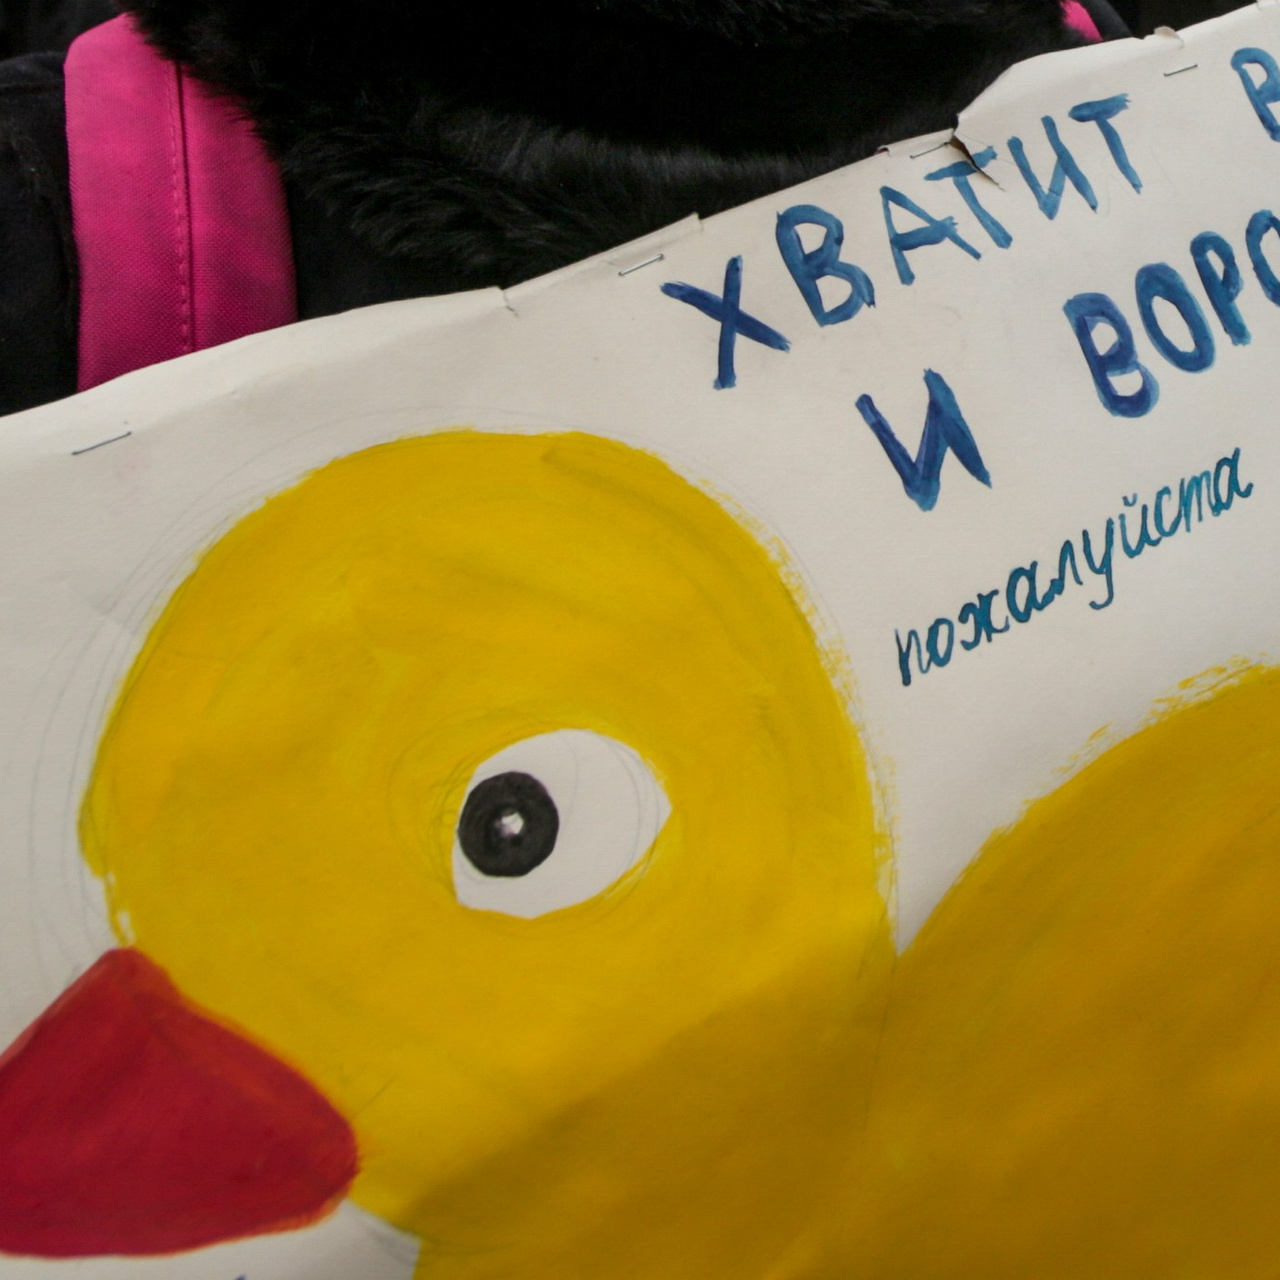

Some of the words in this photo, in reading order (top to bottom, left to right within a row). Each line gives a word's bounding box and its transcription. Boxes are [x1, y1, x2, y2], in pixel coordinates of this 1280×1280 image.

[661, 94, 1142, 392] ХВАТИТ
[855, 368, 992, 512] И
[892, 447, 1254, 687] пожалуйста
